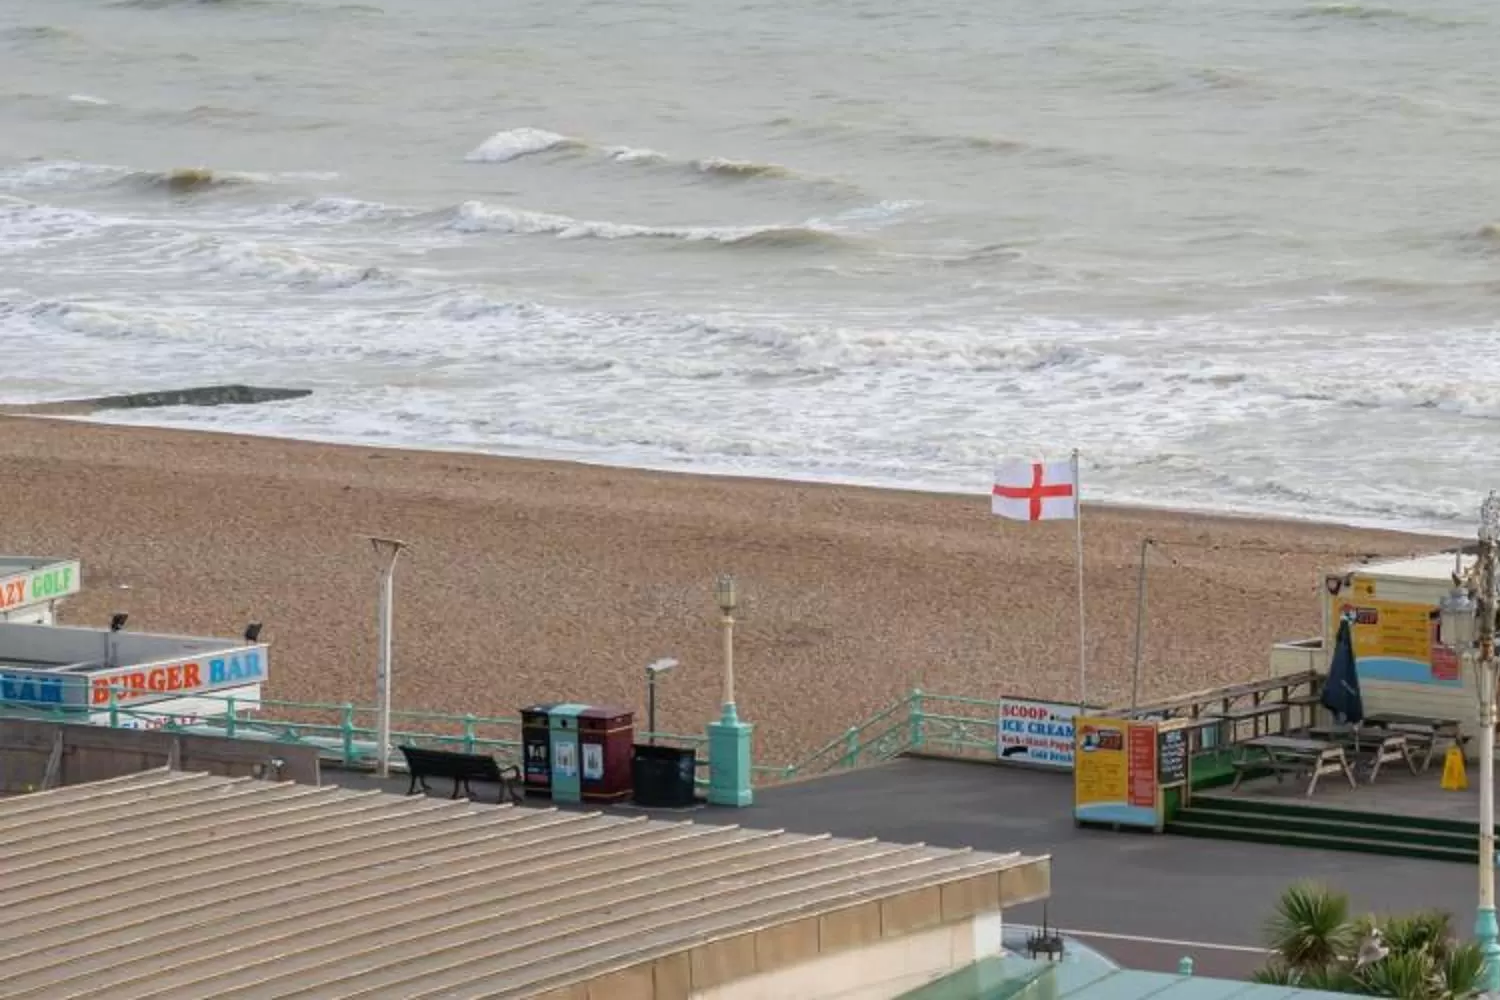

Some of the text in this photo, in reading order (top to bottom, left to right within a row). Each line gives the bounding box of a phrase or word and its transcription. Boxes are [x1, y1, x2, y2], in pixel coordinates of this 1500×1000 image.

[32, 567, 72, 598] GOLF
[93, 652, 262, 704] BURGER BAR
[1002, 704, 1048, 720] SCOOP
[1002, 719, 1025, 733] ICE
